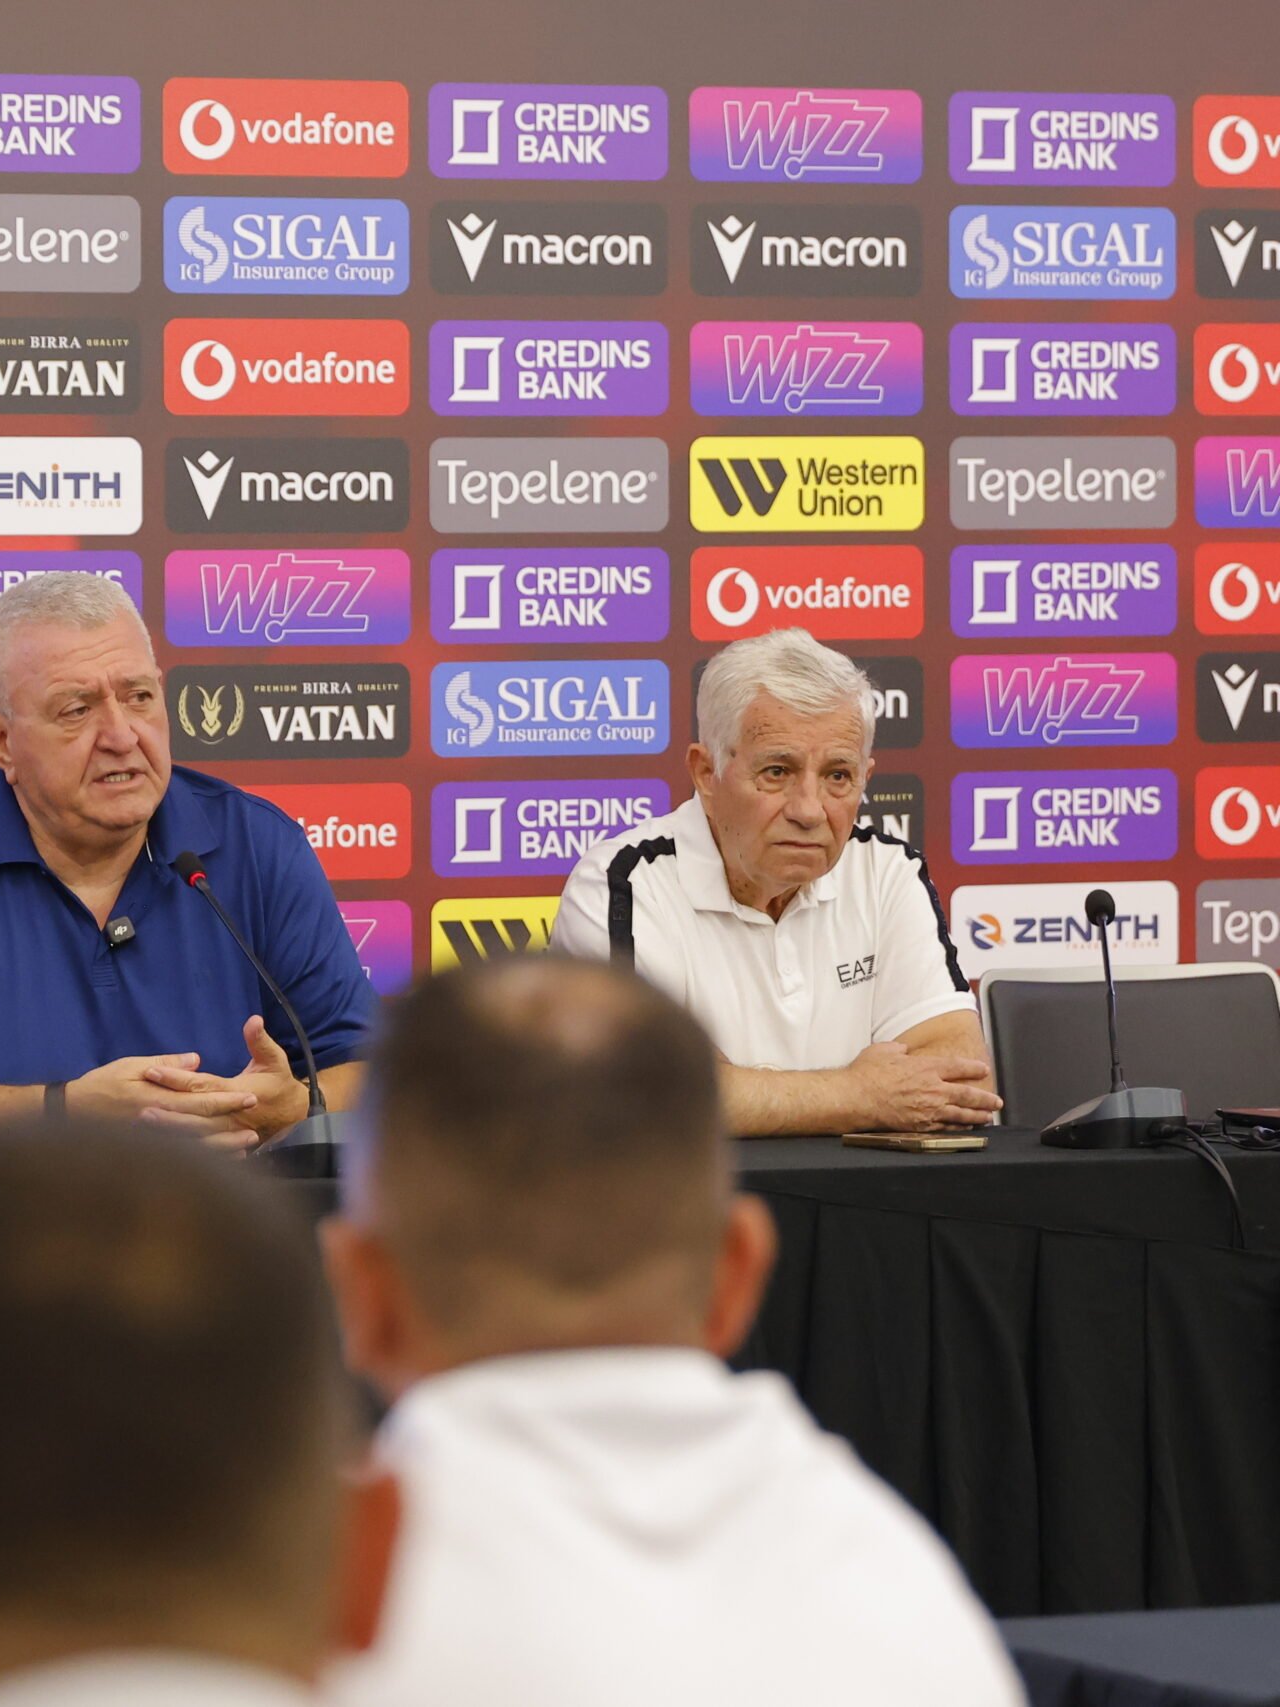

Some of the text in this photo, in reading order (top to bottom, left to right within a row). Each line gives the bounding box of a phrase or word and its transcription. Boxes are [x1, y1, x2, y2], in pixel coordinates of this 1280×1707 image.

[242, 112, 394, 145] vodafone
[515, 103, 650, 133] CREDINS
[1031, 111, 1158, 140] CREDINS
[518, 135, 606, 163] BANK
[1033, 141, 1117, 170] BANK
[233, 214, 395, 260] SIGAL
[504, 235, 651, 265] macron
[1013, 222, 1163, 266] SIGAL
[763, 237, 906, 267] macron
[180, 262, 394, 284] IG Insurance Group
[965, 268, 1162, 289] IG Insurance Group
[31, 336, 81, 348] BIRRA
[515, 340, 650, 368] CREDINS
[1031, 341, 1159, 369] CREDINS
[242, 352, 395, 383] vodafone
[519, 371, 606, 399] BANK
[1034, 372, 1118, 400] BANK
[797, 458, 917, 485] Western
[241, 472, 393, 501] macron
[798, 488, 882, 516] Union
[516, 566, 651, 595] CREDINS
[1032, 561, 1160, 590] CREDINS
[765, 577, 910, 608] vodafone
[1035, 592, 1118, 621] BANK
[520, 598, 607, 626] BANK
[303, 682, 352, 694] BIRRA
[357, 684, 399, 692] QUALITY
[498, 677, 655, 722] SIGAL
[260, 705, 395, 741] VATAN
[447, 724, 655, 744] IG Insurance Group
[517, 797, 652, 827] CREDINS
[1032, 786, 1161, 817] CREDINS
[297, 816, 398, 848] afone
[1036, 818, 1119, 847] BANK
[836, 954, 875, 983] EA7
